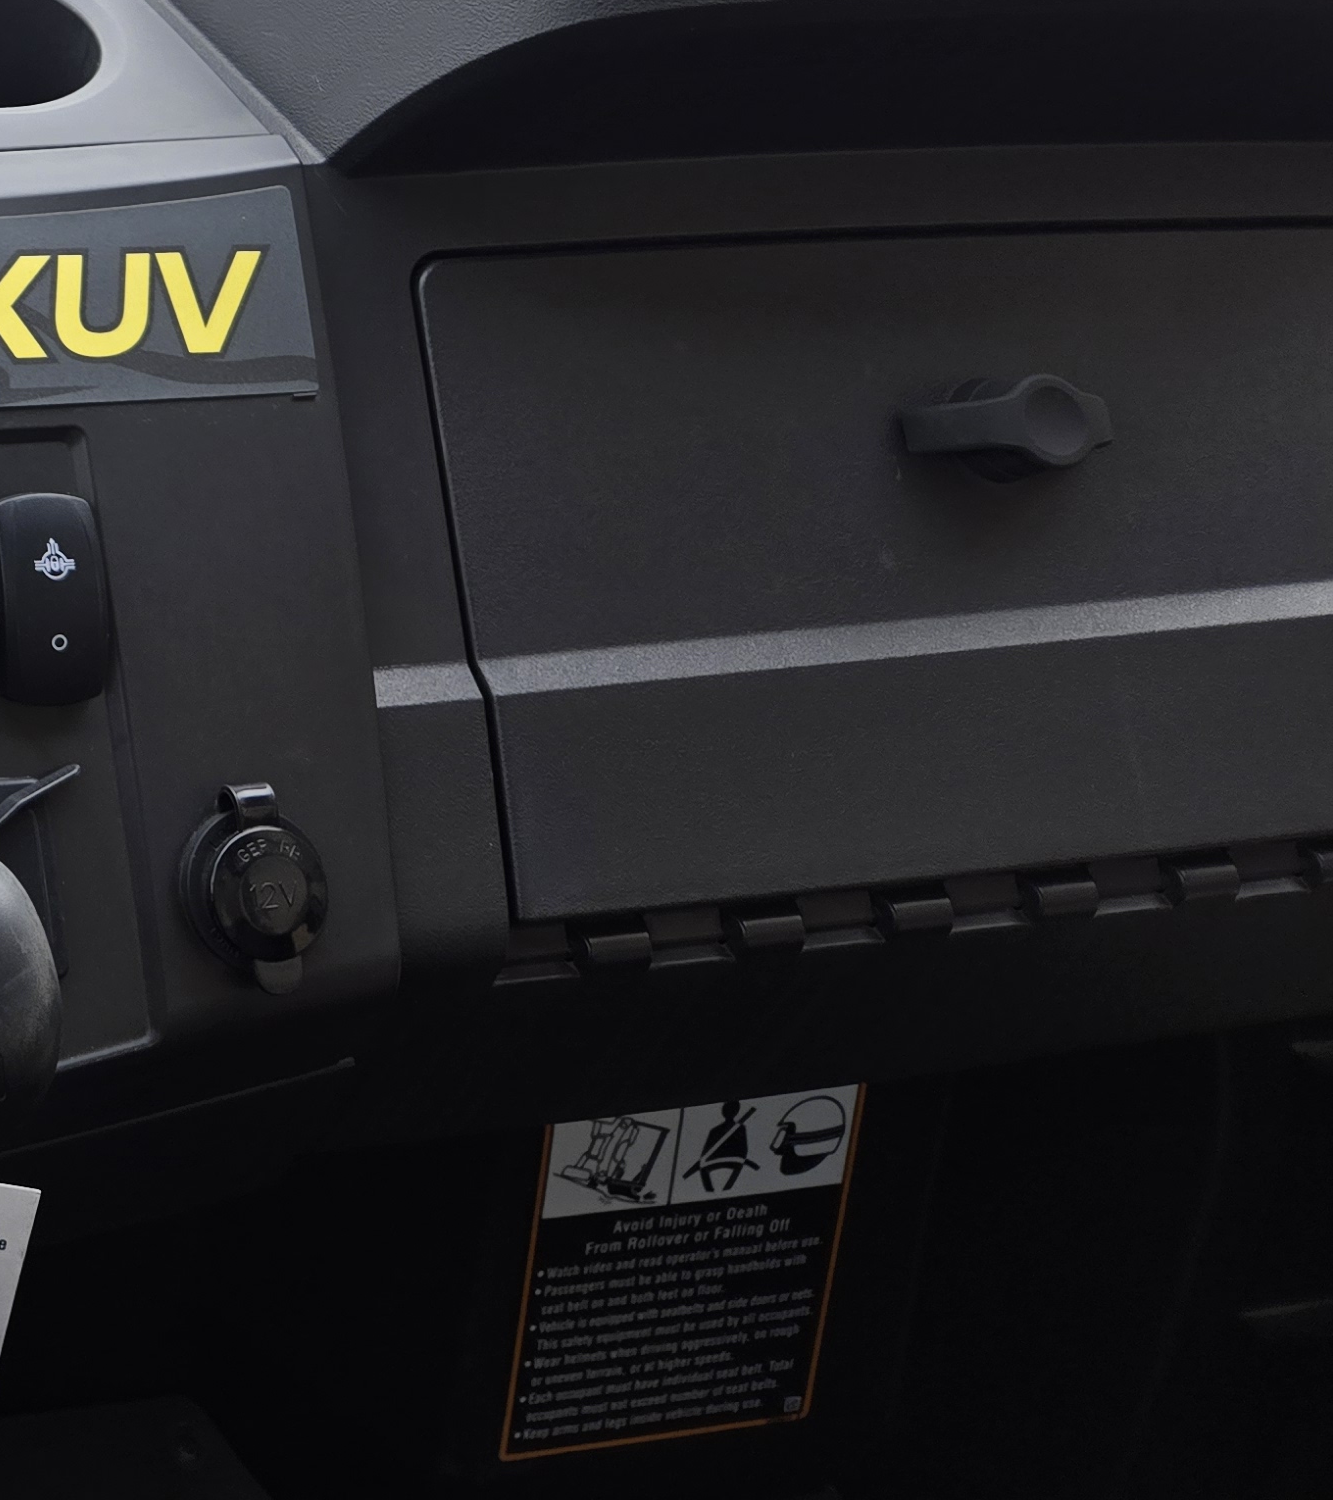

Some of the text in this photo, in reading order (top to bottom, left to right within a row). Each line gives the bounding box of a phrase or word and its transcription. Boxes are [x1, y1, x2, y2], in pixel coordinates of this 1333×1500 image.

[249, 881, 296, 910] 12V
[612, 1202, 768, 1234] Avoid Injury or Death
[584, 1216, 790, 1256] From Rollover or Falling Off
